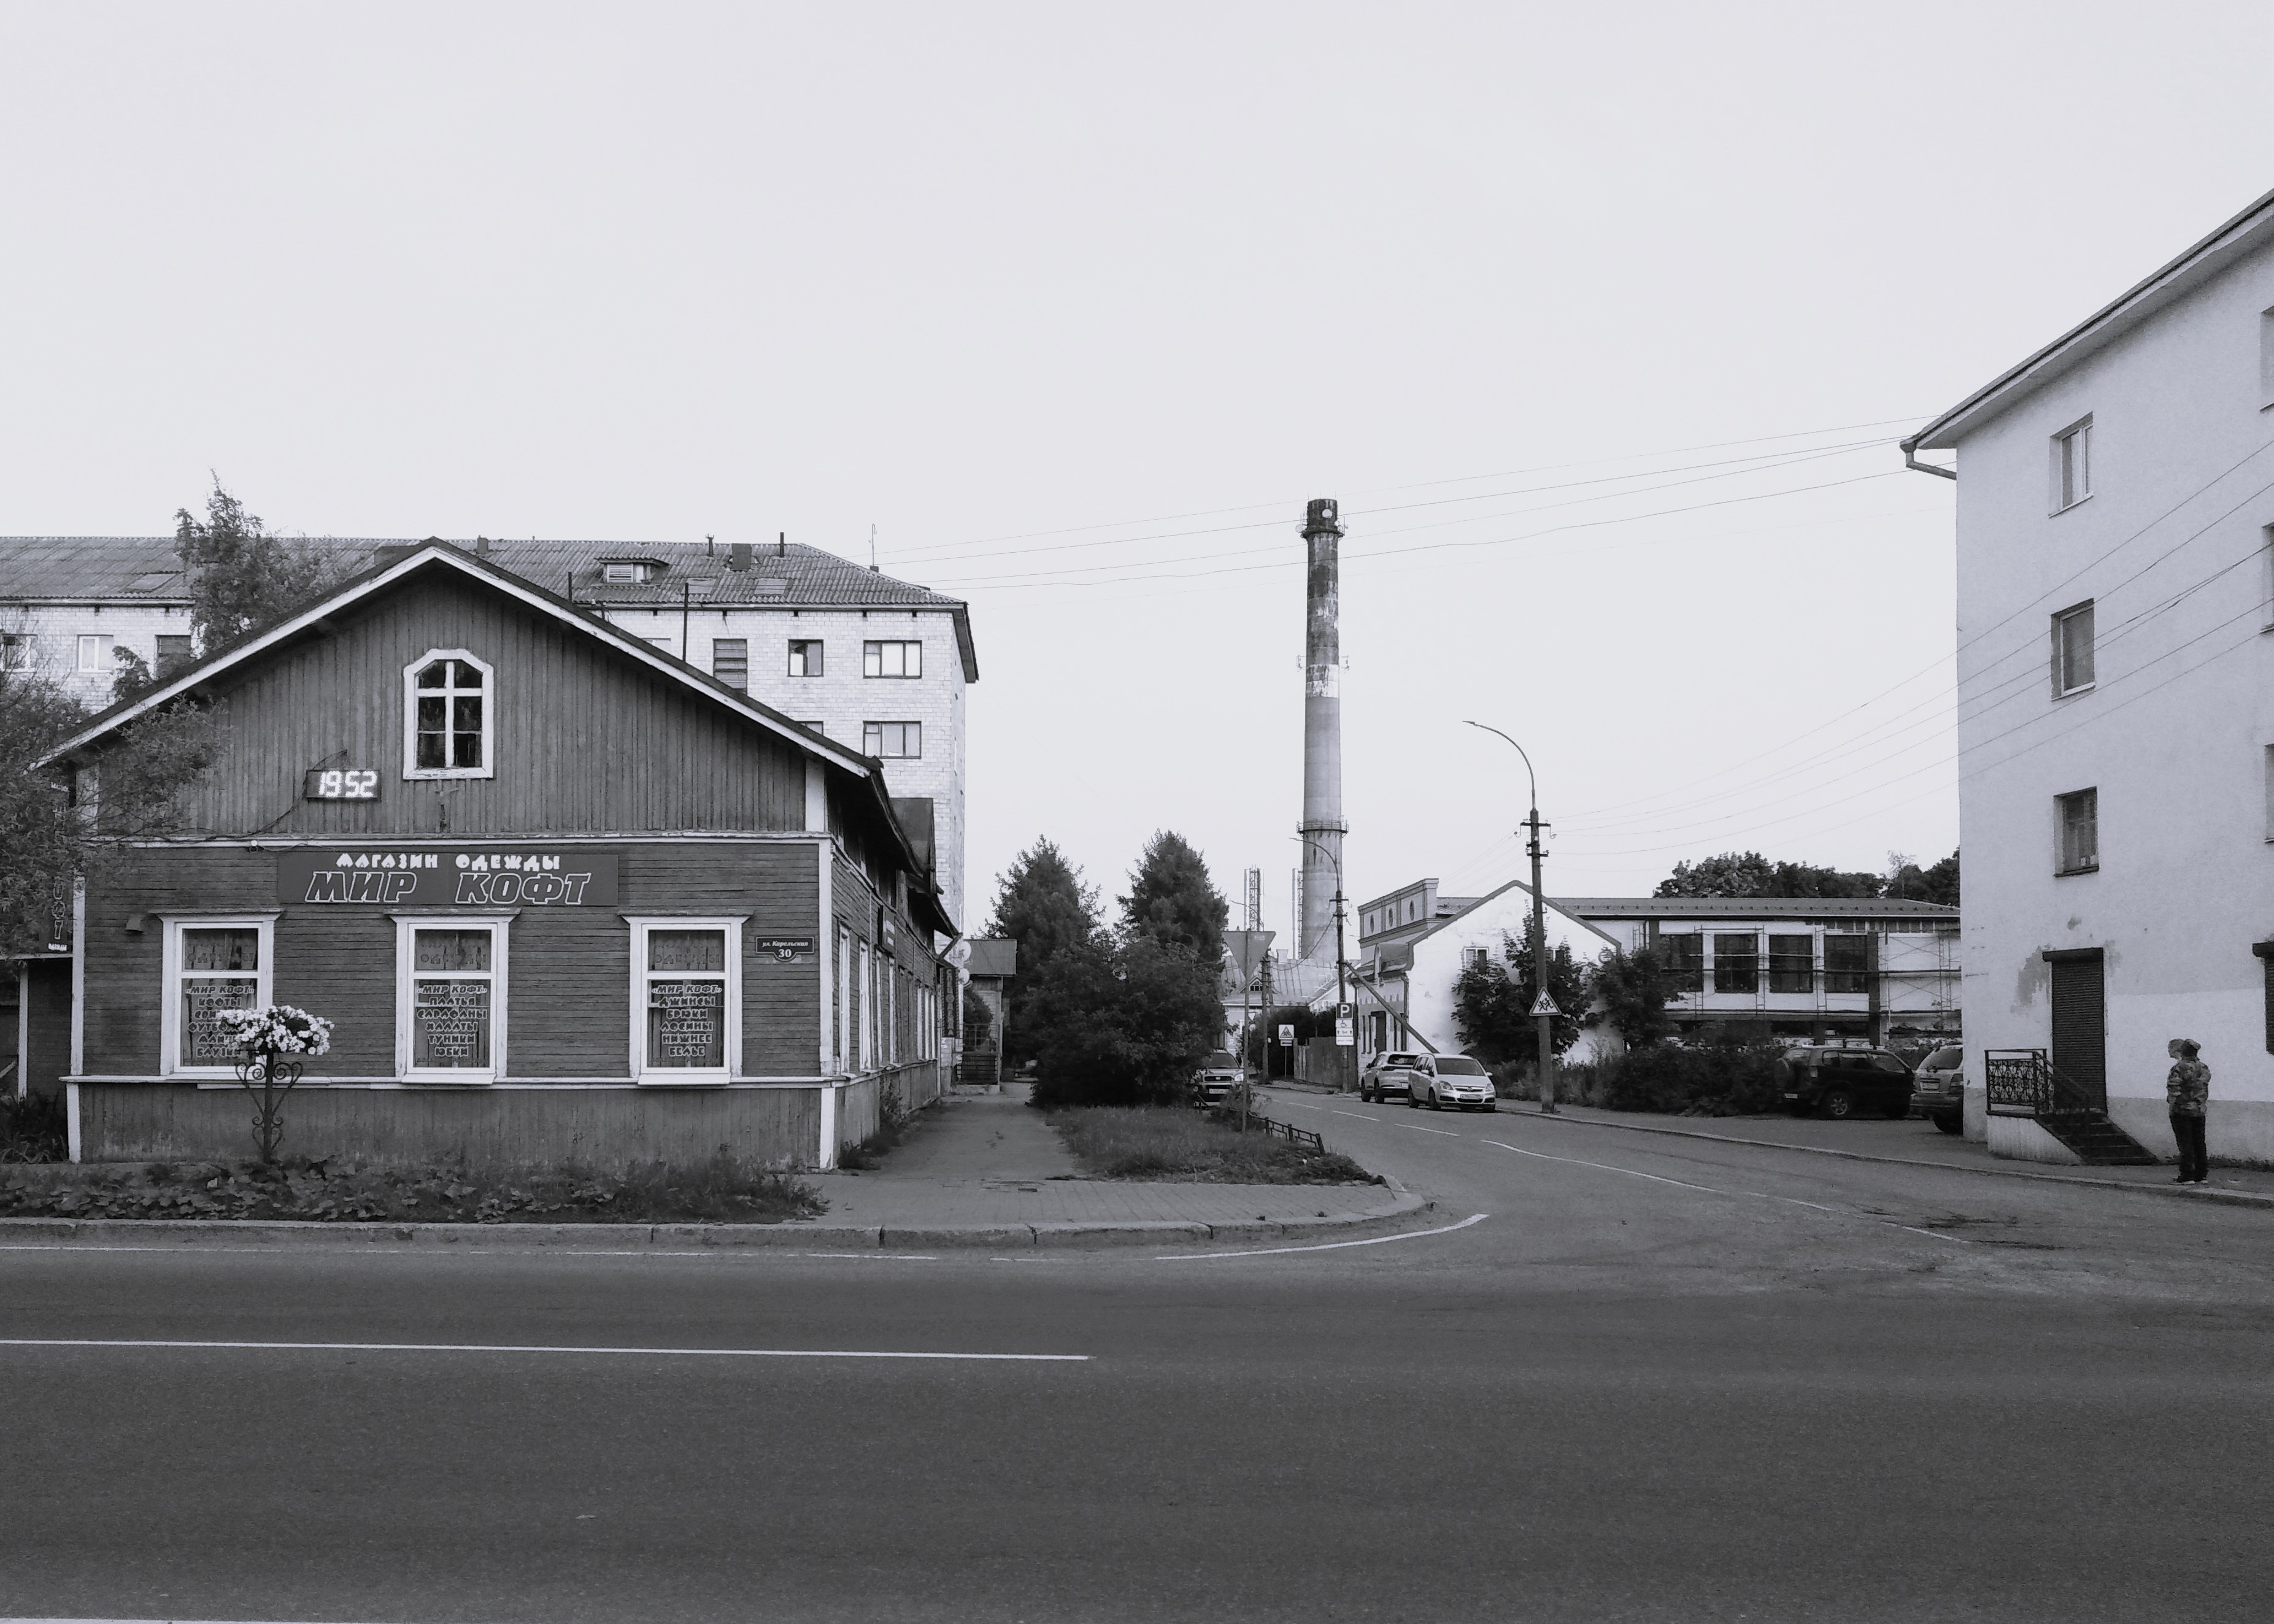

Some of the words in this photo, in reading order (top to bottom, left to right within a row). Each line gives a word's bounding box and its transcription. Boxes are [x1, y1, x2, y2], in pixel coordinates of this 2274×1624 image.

[336, 853, 438, 869] МАГАЗИН
[456, 853, 560, 871] ОДЕЖДЫ
[305, 872, 417, 903] МИР
[455, 873, 592, 904] КОФТ
[778, 949, 792, 958] 30
[198, 997, 242, 1007] КОФТЫ
[429, 996, 476, 1007] ПЛАТЬЯ
[658, 996, 716, 1008] ДЖИНСЫ
[417, 1009, 488, 1019] САРАФАНЫ
[666, 1008, 708, 1019] БРЮКИ
[1340, 1004, 1350, 1018] P
[425, 1022, 478, 1032] ХАЛАТЫ
[660, 1020, 714, 1032] ЛОСИНЫ
[428, 1033, 476, 1044] ТУНИКИ
[661, 1033, 712, 1044] НИЖНЕЕ
[434, 1045, 469, 1057] ЮБКИ
[668, 1046, 705, 1056] БЕЛЬЕ
